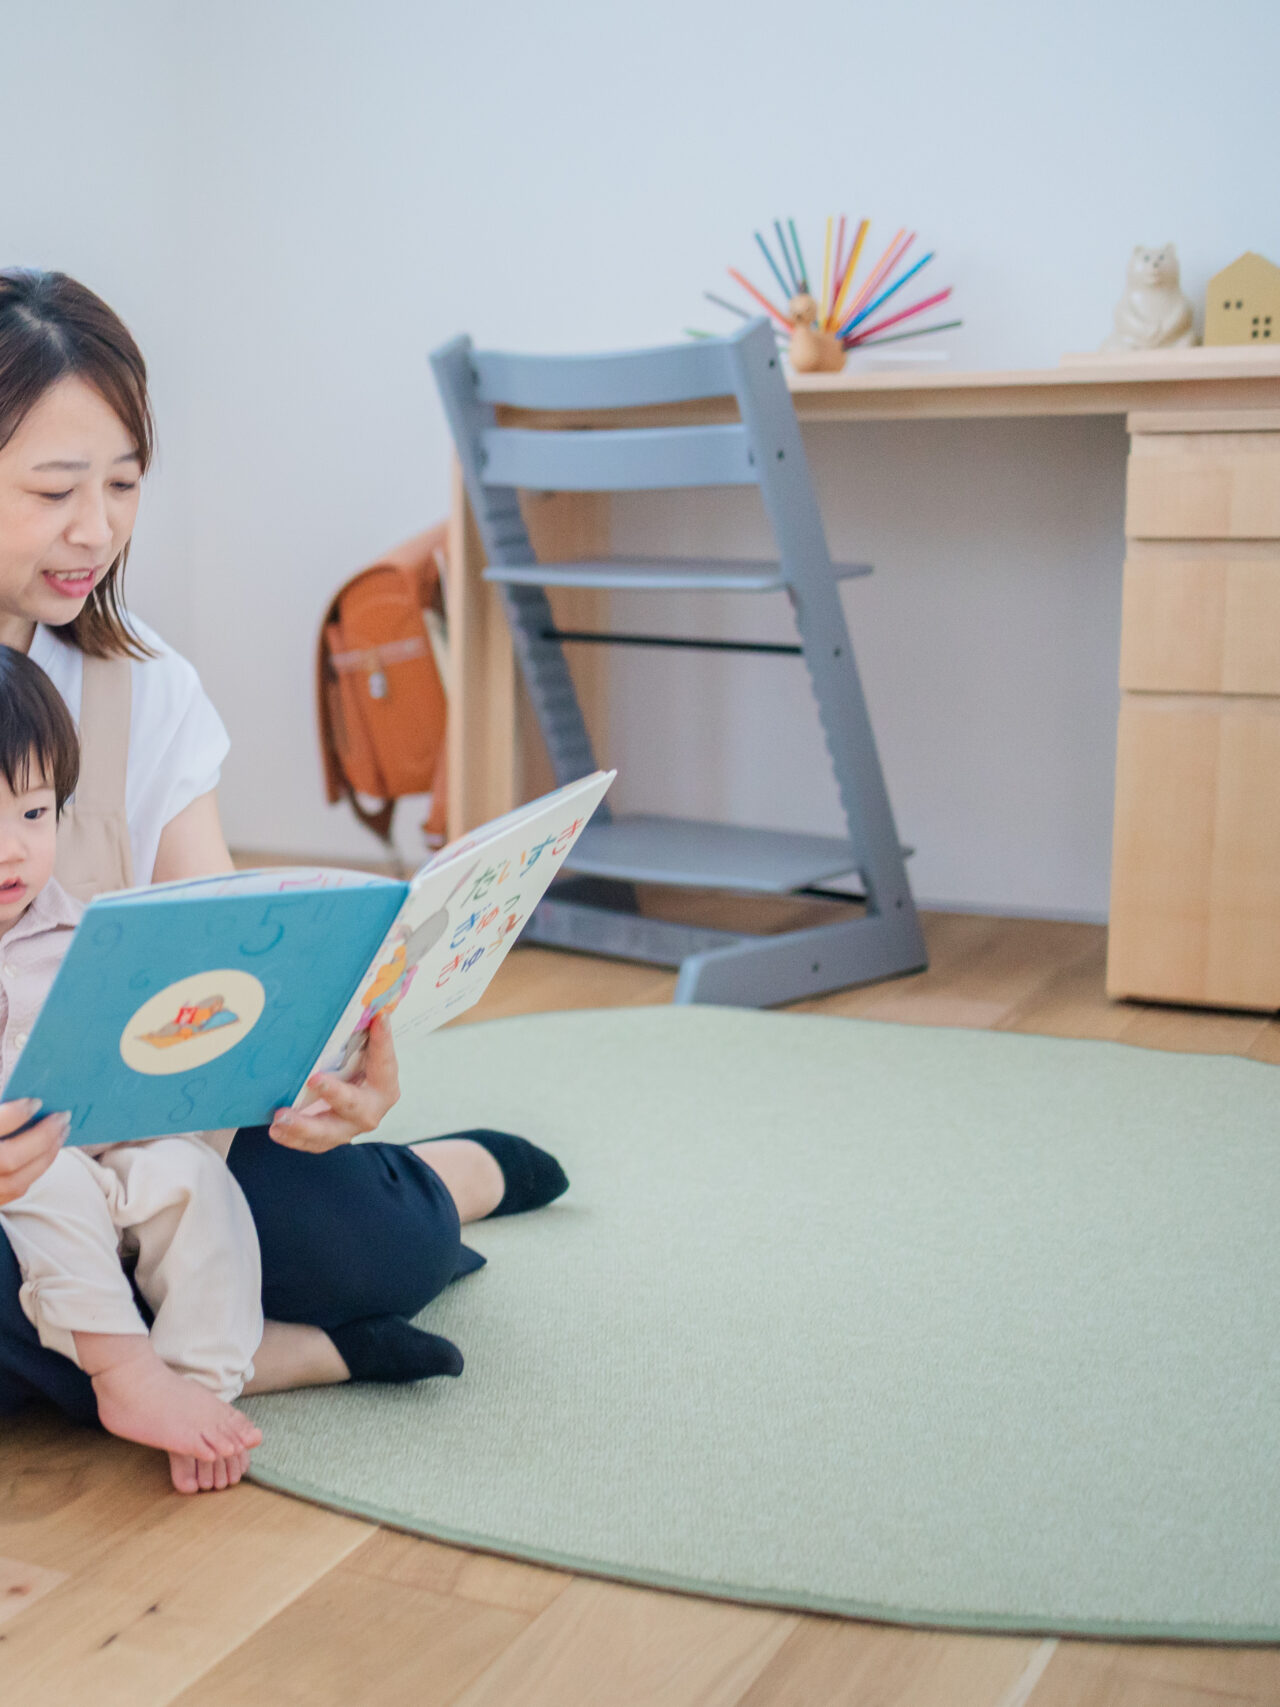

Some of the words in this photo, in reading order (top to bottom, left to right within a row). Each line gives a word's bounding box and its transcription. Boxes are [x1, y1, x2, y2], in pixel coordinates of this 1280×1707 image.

[460, 817, 584, 909] だいすき
[449, 894, 521, 949] ぎゅっ
[435, 939, 504, 988] ぎゅっ
